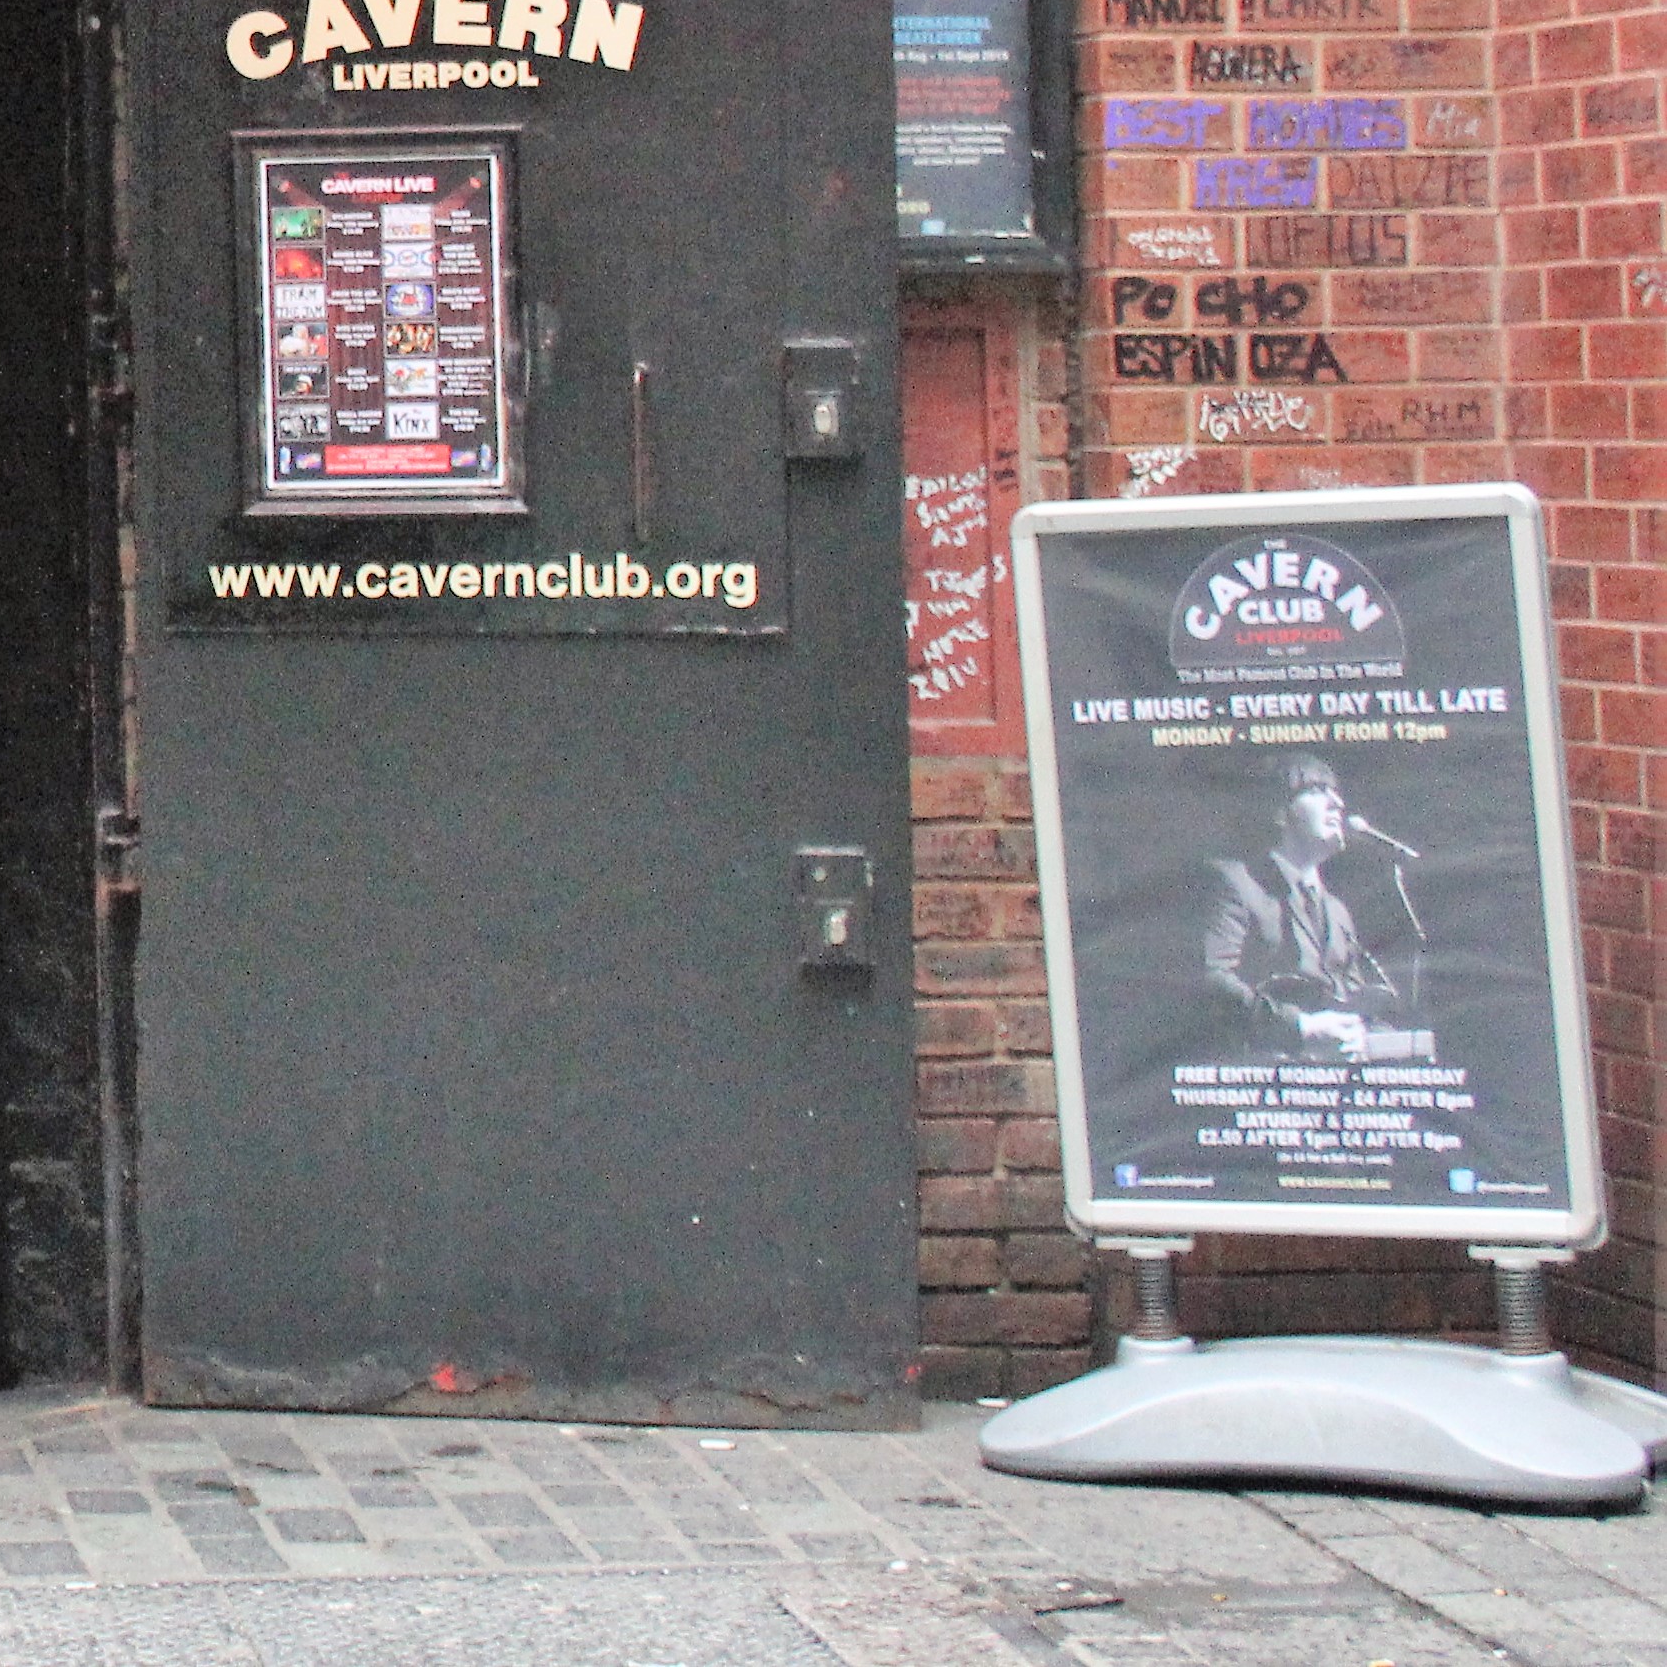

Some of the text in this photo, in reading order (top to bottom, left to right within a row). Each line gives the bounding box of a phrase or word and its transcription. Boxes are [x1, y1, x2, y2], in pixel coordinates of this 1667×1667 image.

[333, 60, 540, 91] LIVERPOOL
[1104, 99, 1224, 150] BEST
[321, 177, 436, 194] CAVERN LIVE
[209, 553, 759, 609] www.cavernclub.org
[1184, 552, 1384, 640] CAVERN
[1238, 598, 1324, 624] CLUB
[1235, 628, 1344, 645] LIVERPOOL
[1072, 687, 1508, 723] LIVE MUSIC EVERY DAY TILL LATE
[1152, 721, 1448, 746] MONDAY SUNDAY FROM 12pm
[1174, 1066, 1465, 1085] FREE ENTRY MONDAY WEDNESDAY
[1235, 1111, 1414, 1130] SATURDAY & SUNDAY
